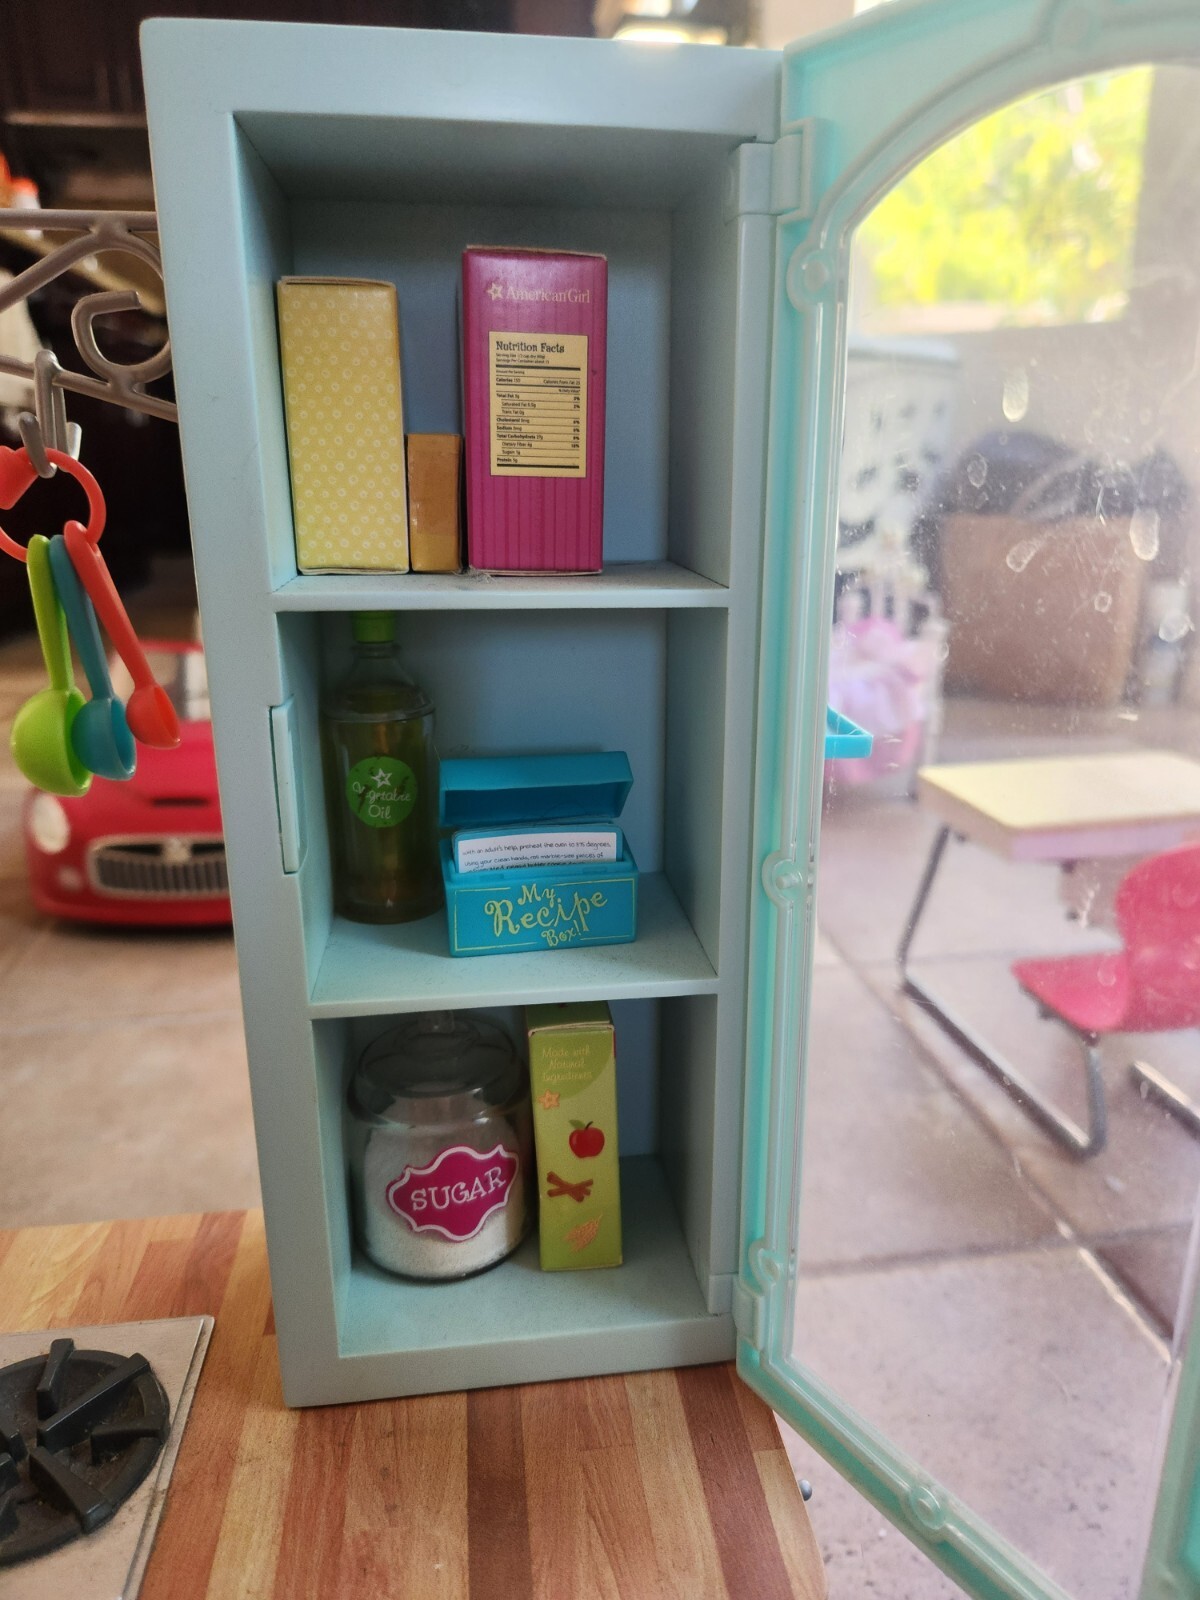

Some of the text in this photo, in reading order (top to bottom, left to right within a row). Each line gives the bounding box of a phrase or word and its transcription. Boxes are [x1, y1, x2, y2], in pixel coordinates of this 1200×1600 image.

[496, 341, 564, 353] Nutrition Facts
[368, 804, 391, 819] Oil
[519, 843, 542, 851] preheat
[518, 883, 556, 907] My
[484, 891, 608, 937] Recipe
[541, 920, 582, 947] Box!
[543, 1044, 590, 1057] Made with
[410, 1166, 507, 1211] SUGAR
